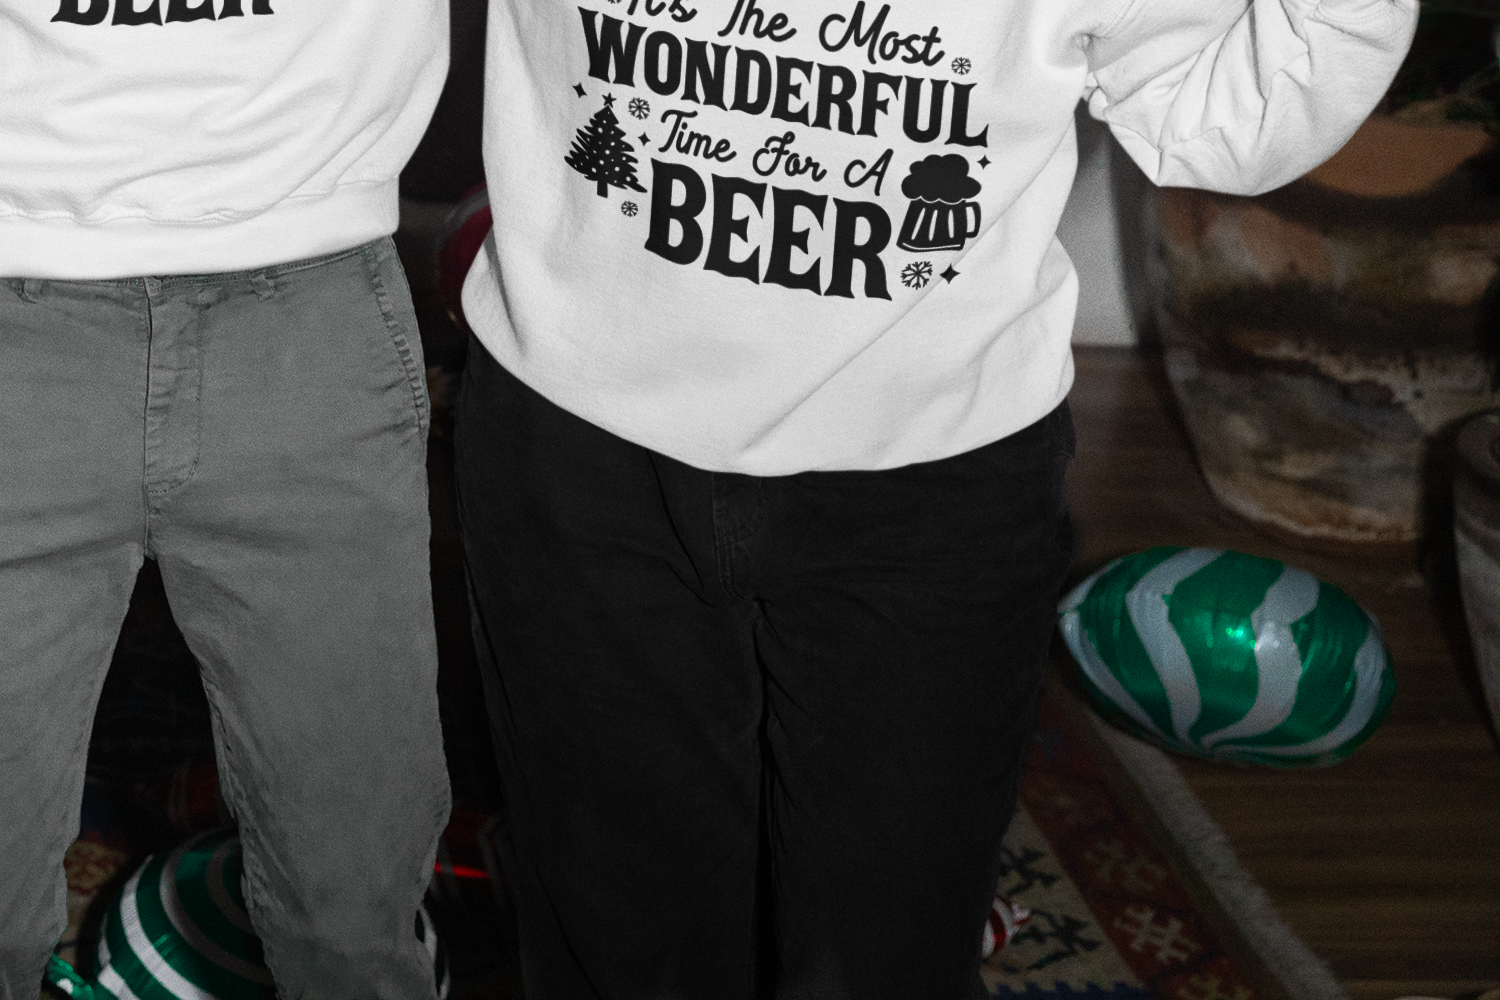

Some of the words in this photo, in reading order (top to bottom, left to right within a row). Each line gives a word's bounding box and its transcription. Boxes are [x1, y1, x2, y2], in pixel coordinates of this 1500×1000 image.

[577, 5, 989, 149] WONDERFUL
[818, 0, 945, 67] Most
[658, 109, 737, 163] Time
[752, 130, 828, 178] For
[843, 148, 894, 197] A
[643, 157, 893, 302] BEER
